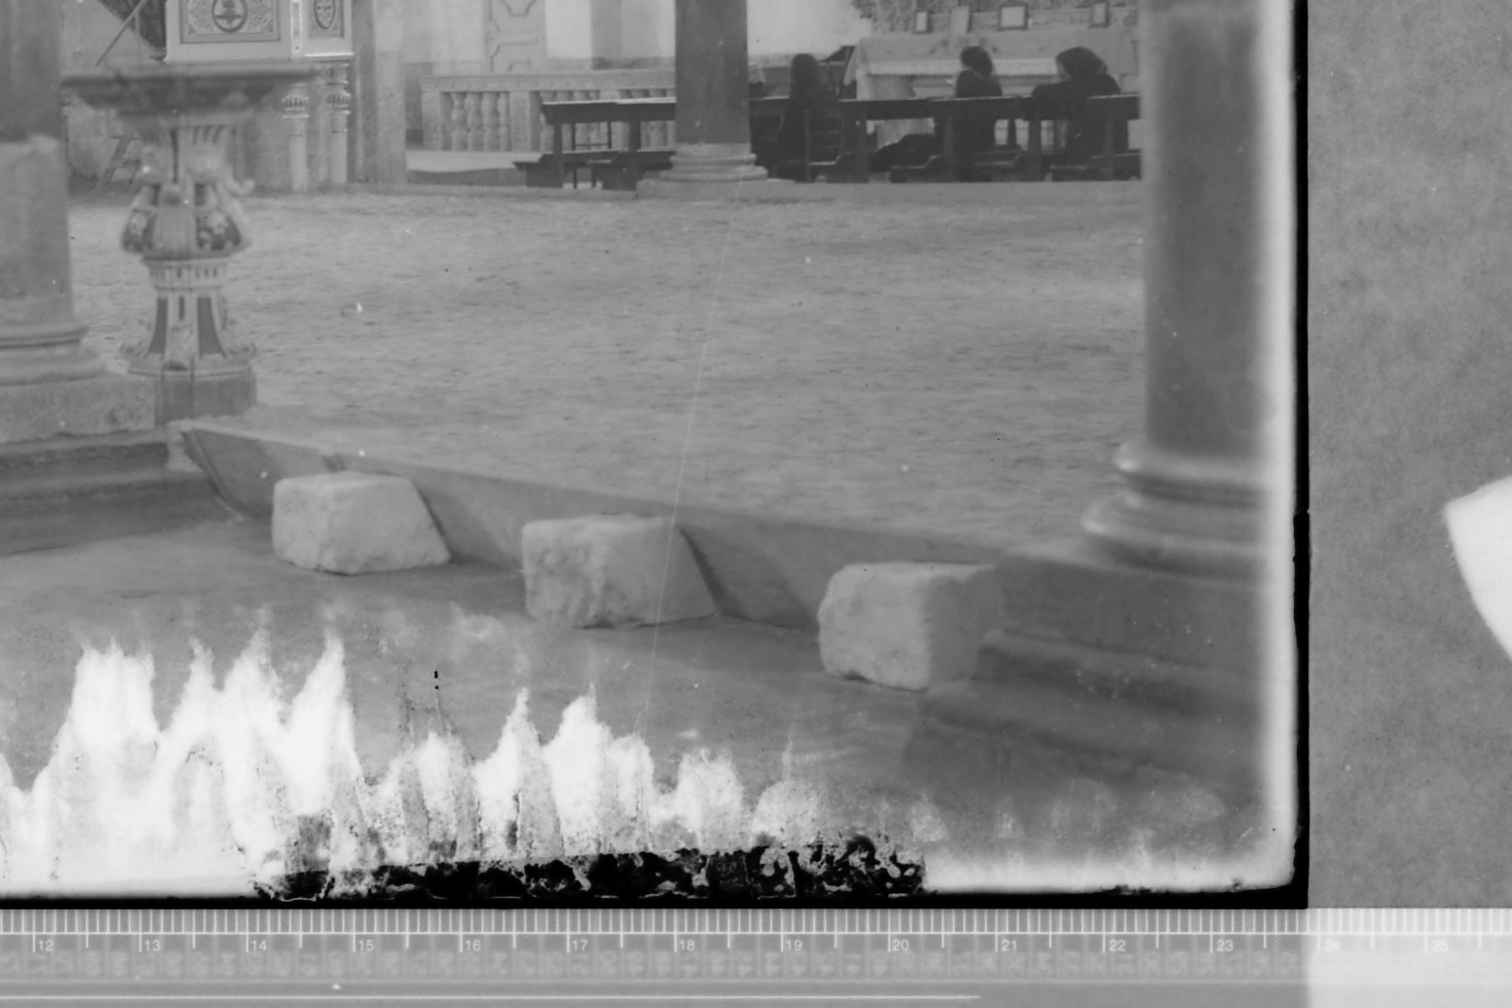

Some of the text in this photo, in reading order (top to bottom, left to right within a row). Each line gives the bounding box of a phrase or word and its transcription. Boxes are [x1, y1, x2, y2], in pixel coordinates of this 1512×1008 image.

[39, 940, 55, 952] 12
[145, 940, 161, 952] 13
[251, 940, 267, 952] 14
[359, 940, 374, 952] 15
[466, 940, 481, 952] 16
[572, 940, 588, 952] 17
[680, 940, 695, 952] 18
[786, 940, 803, 952] 19
[892, 940, 909, 952] 20
[1001, 940, 1017, 952] 21
[1109, 940, 1126, 952] 22
[1216, 940, 1233, 952] 23
